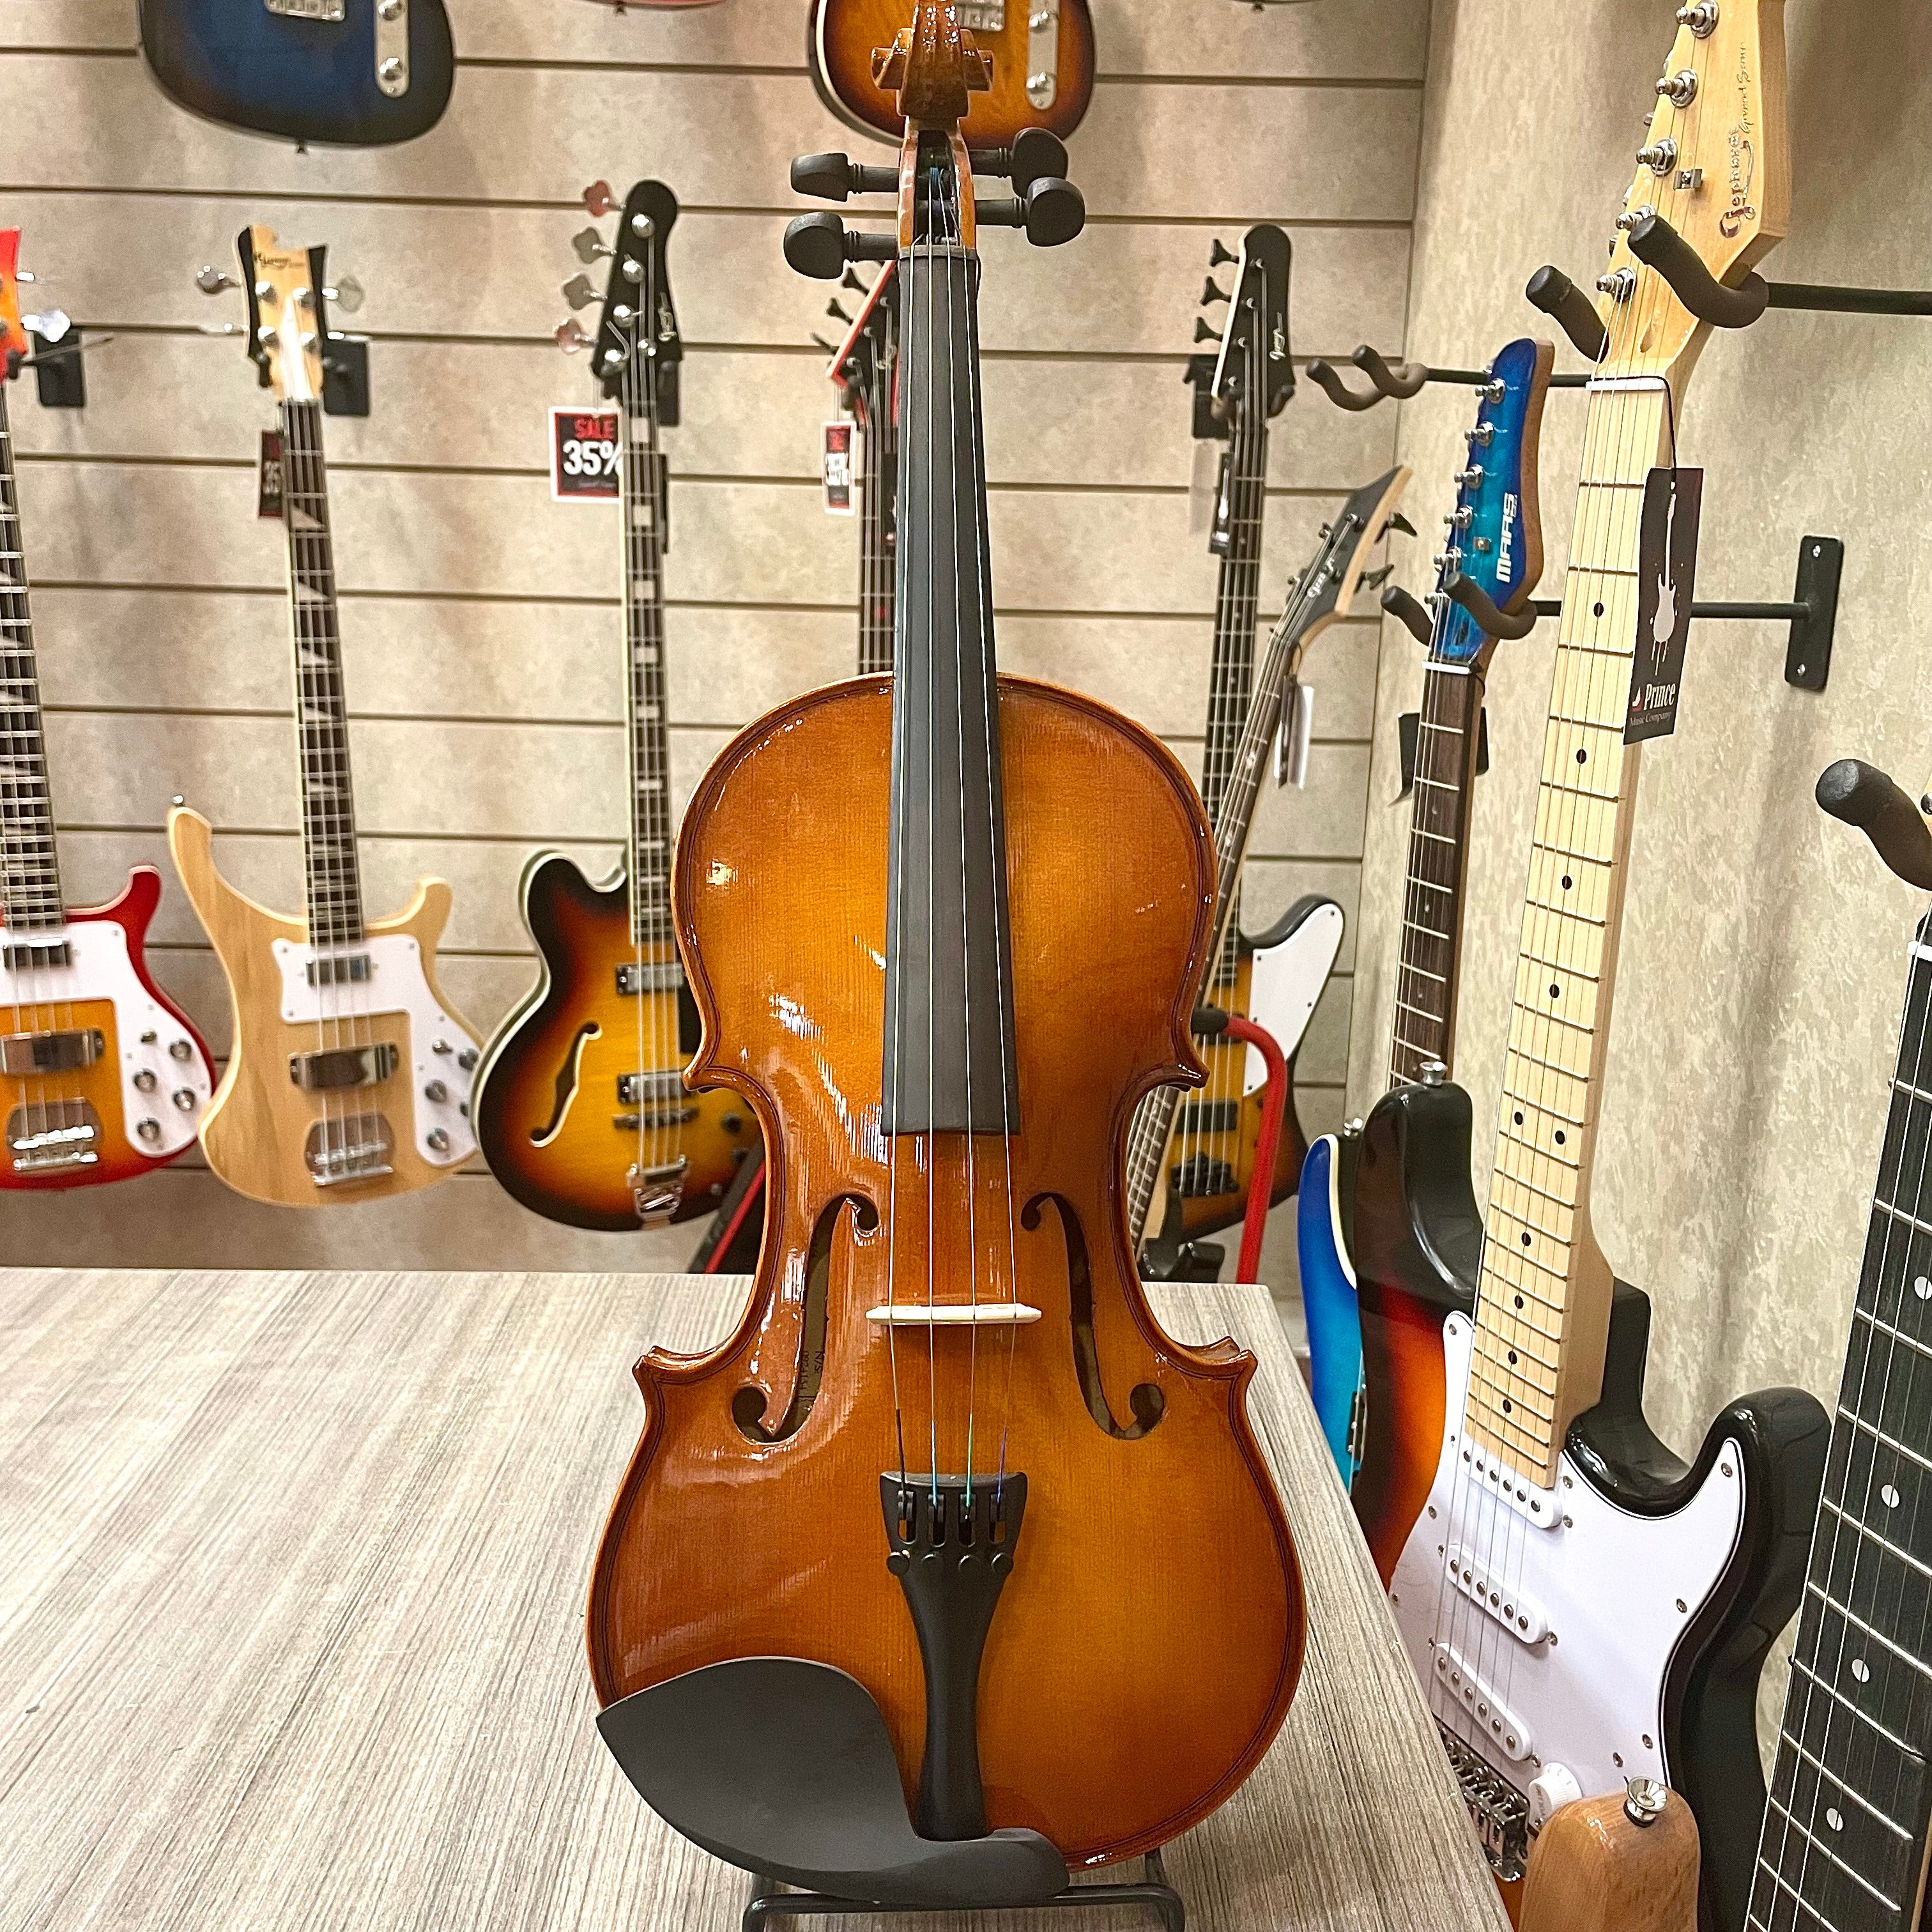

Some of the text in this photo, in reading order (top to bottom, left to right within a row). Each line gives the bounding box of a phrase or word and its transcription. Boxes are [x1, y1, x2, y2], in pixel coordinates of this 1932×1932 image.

[574, 417, 615, 440] SALE
[563, 440, 624, 476] 35%
[1643, 683, 1676, 710] Prince
